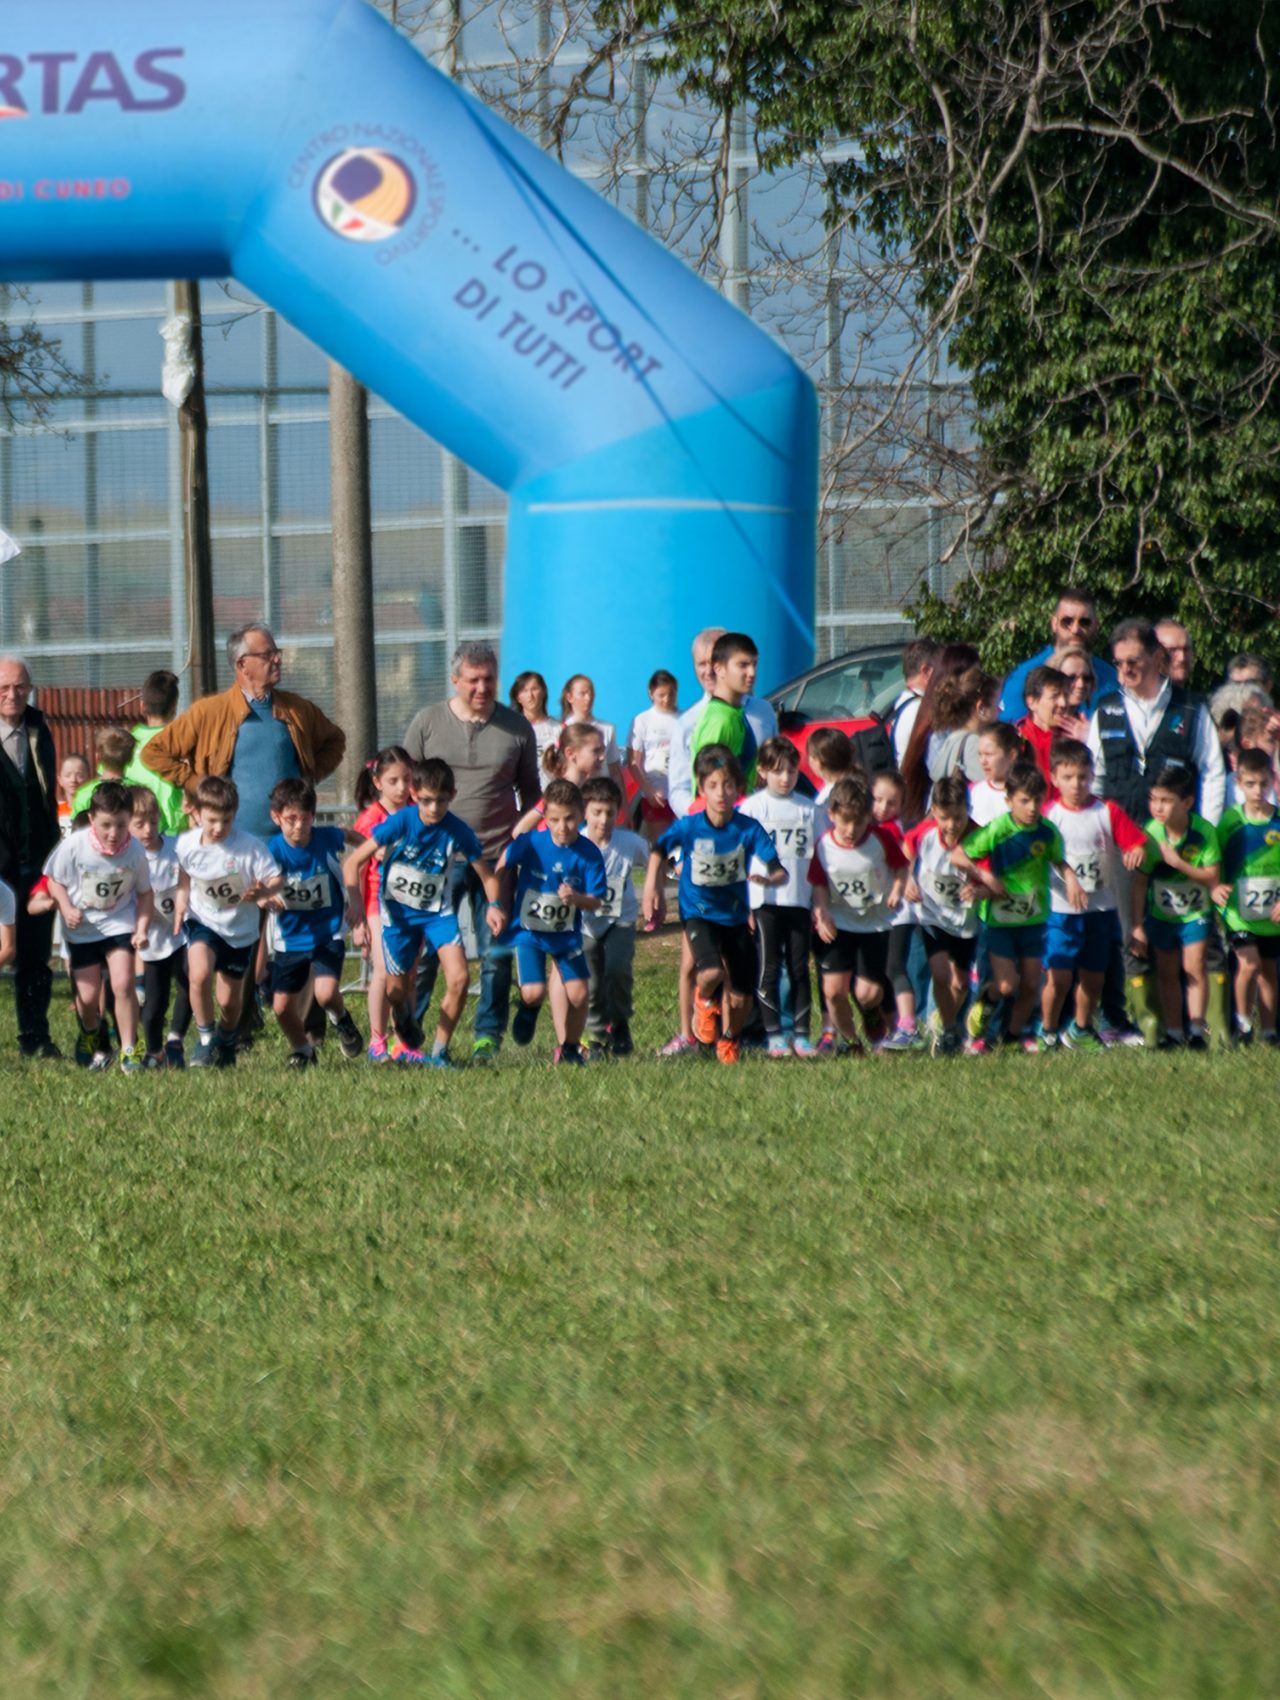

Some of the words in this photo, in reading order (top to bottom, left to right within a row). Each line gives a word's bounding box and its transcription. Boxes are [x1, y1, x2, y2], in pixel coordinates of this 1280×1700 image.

[35, 179, 131, 199] CUNEO
[493, 244, 547, 292] LO
[547, 288, 664, 382] SPORT
[454, 278, 500, 320] DI
[497, 309, 588, 391] TUTTI
[95, 880, 124, 898] 67
[283, 884, 323, 902] 291
[394, 877, 437, 900] 289
[837, 880, 866, 896] 28
[1161, 888, 1204, 908] 232
[527, 901, 571, 921] 290
